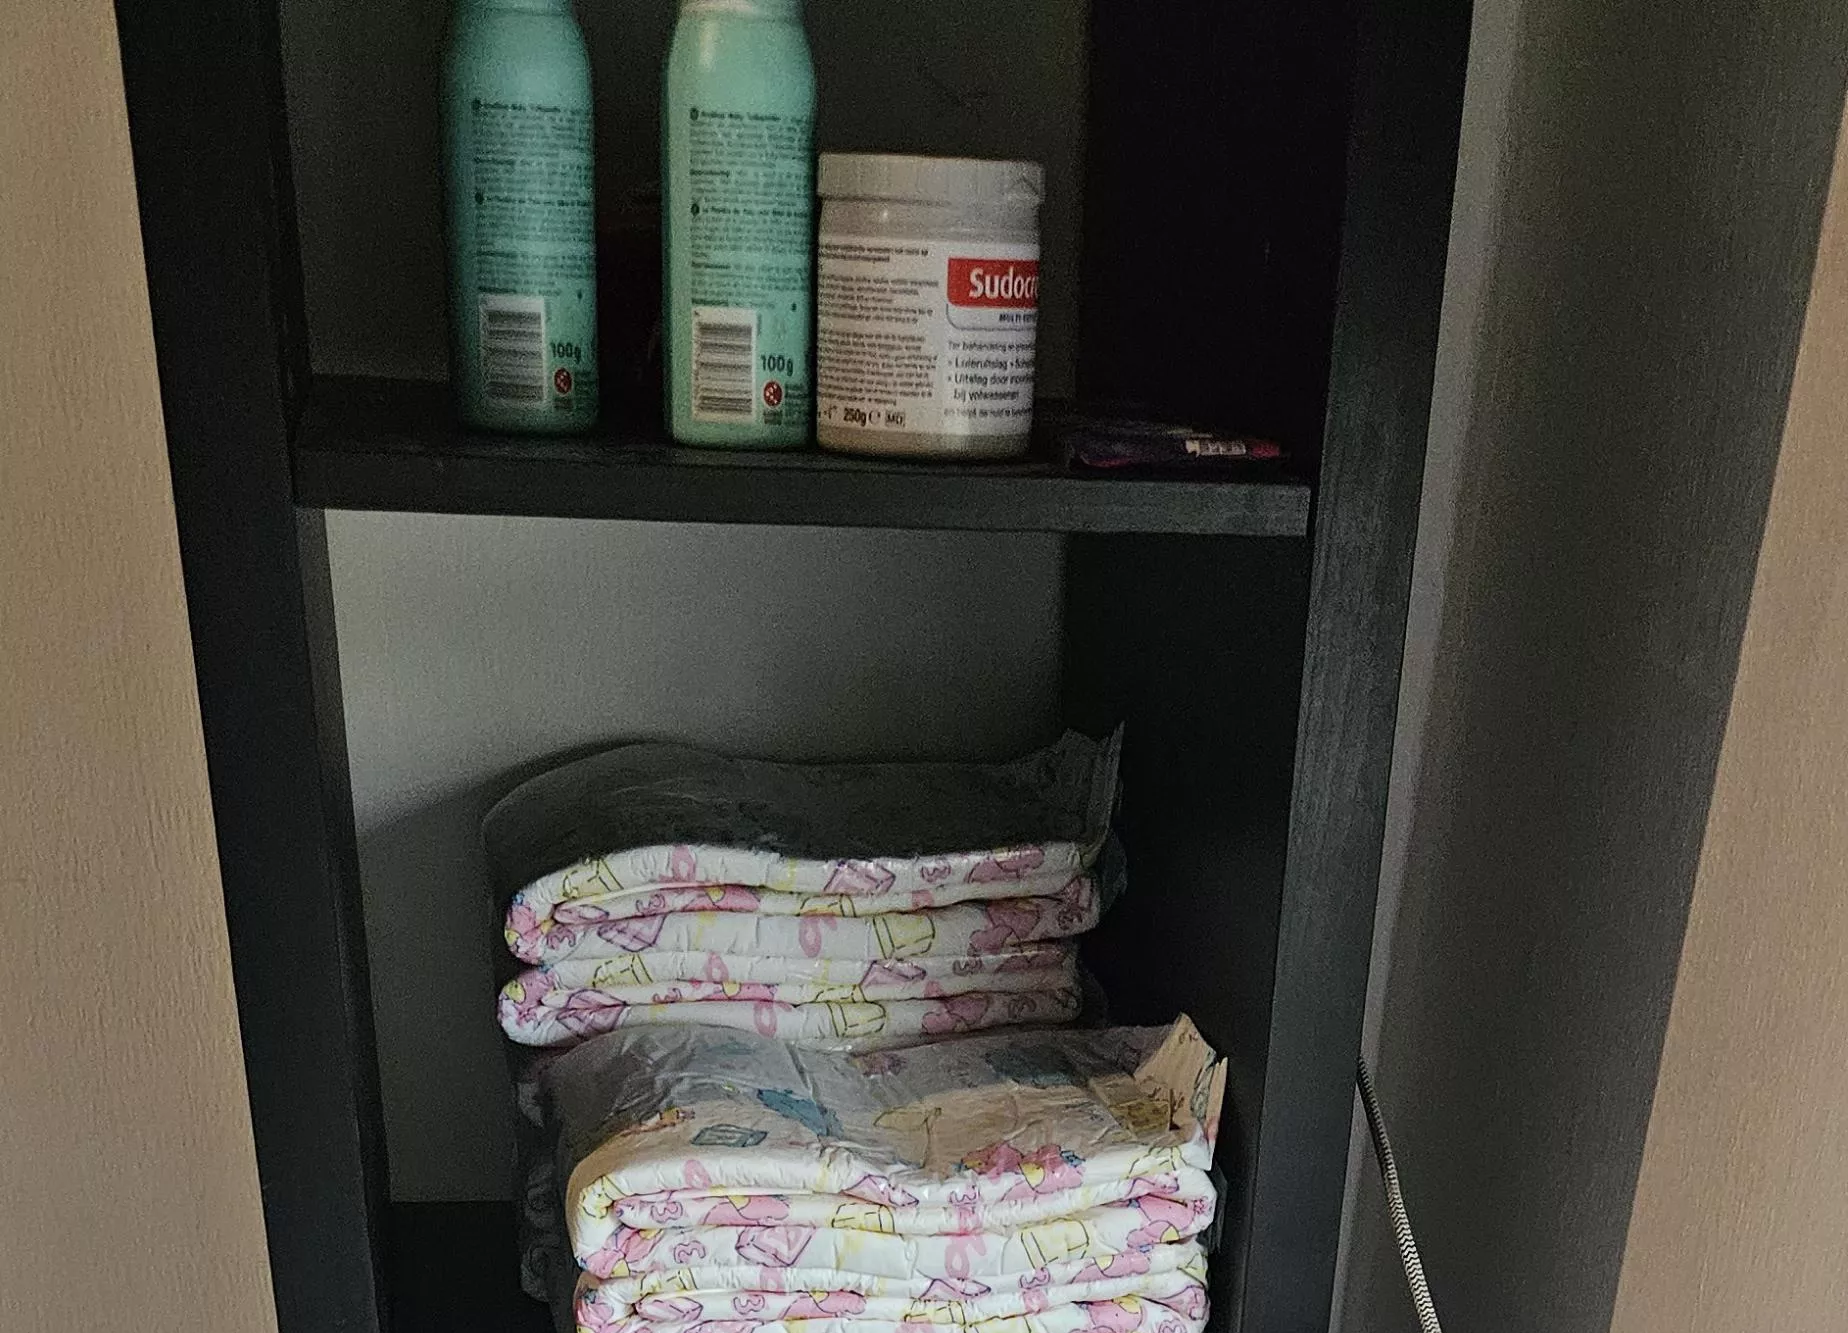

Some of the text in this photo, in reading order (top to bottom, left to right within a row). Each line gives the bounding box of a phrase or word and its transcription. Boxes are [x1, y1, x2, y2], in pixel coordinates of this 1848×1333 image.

[550, 341, 582, 365] 100g
[760, 354, 794, 377] 100g
[843, 406, 867, 427] 250g
